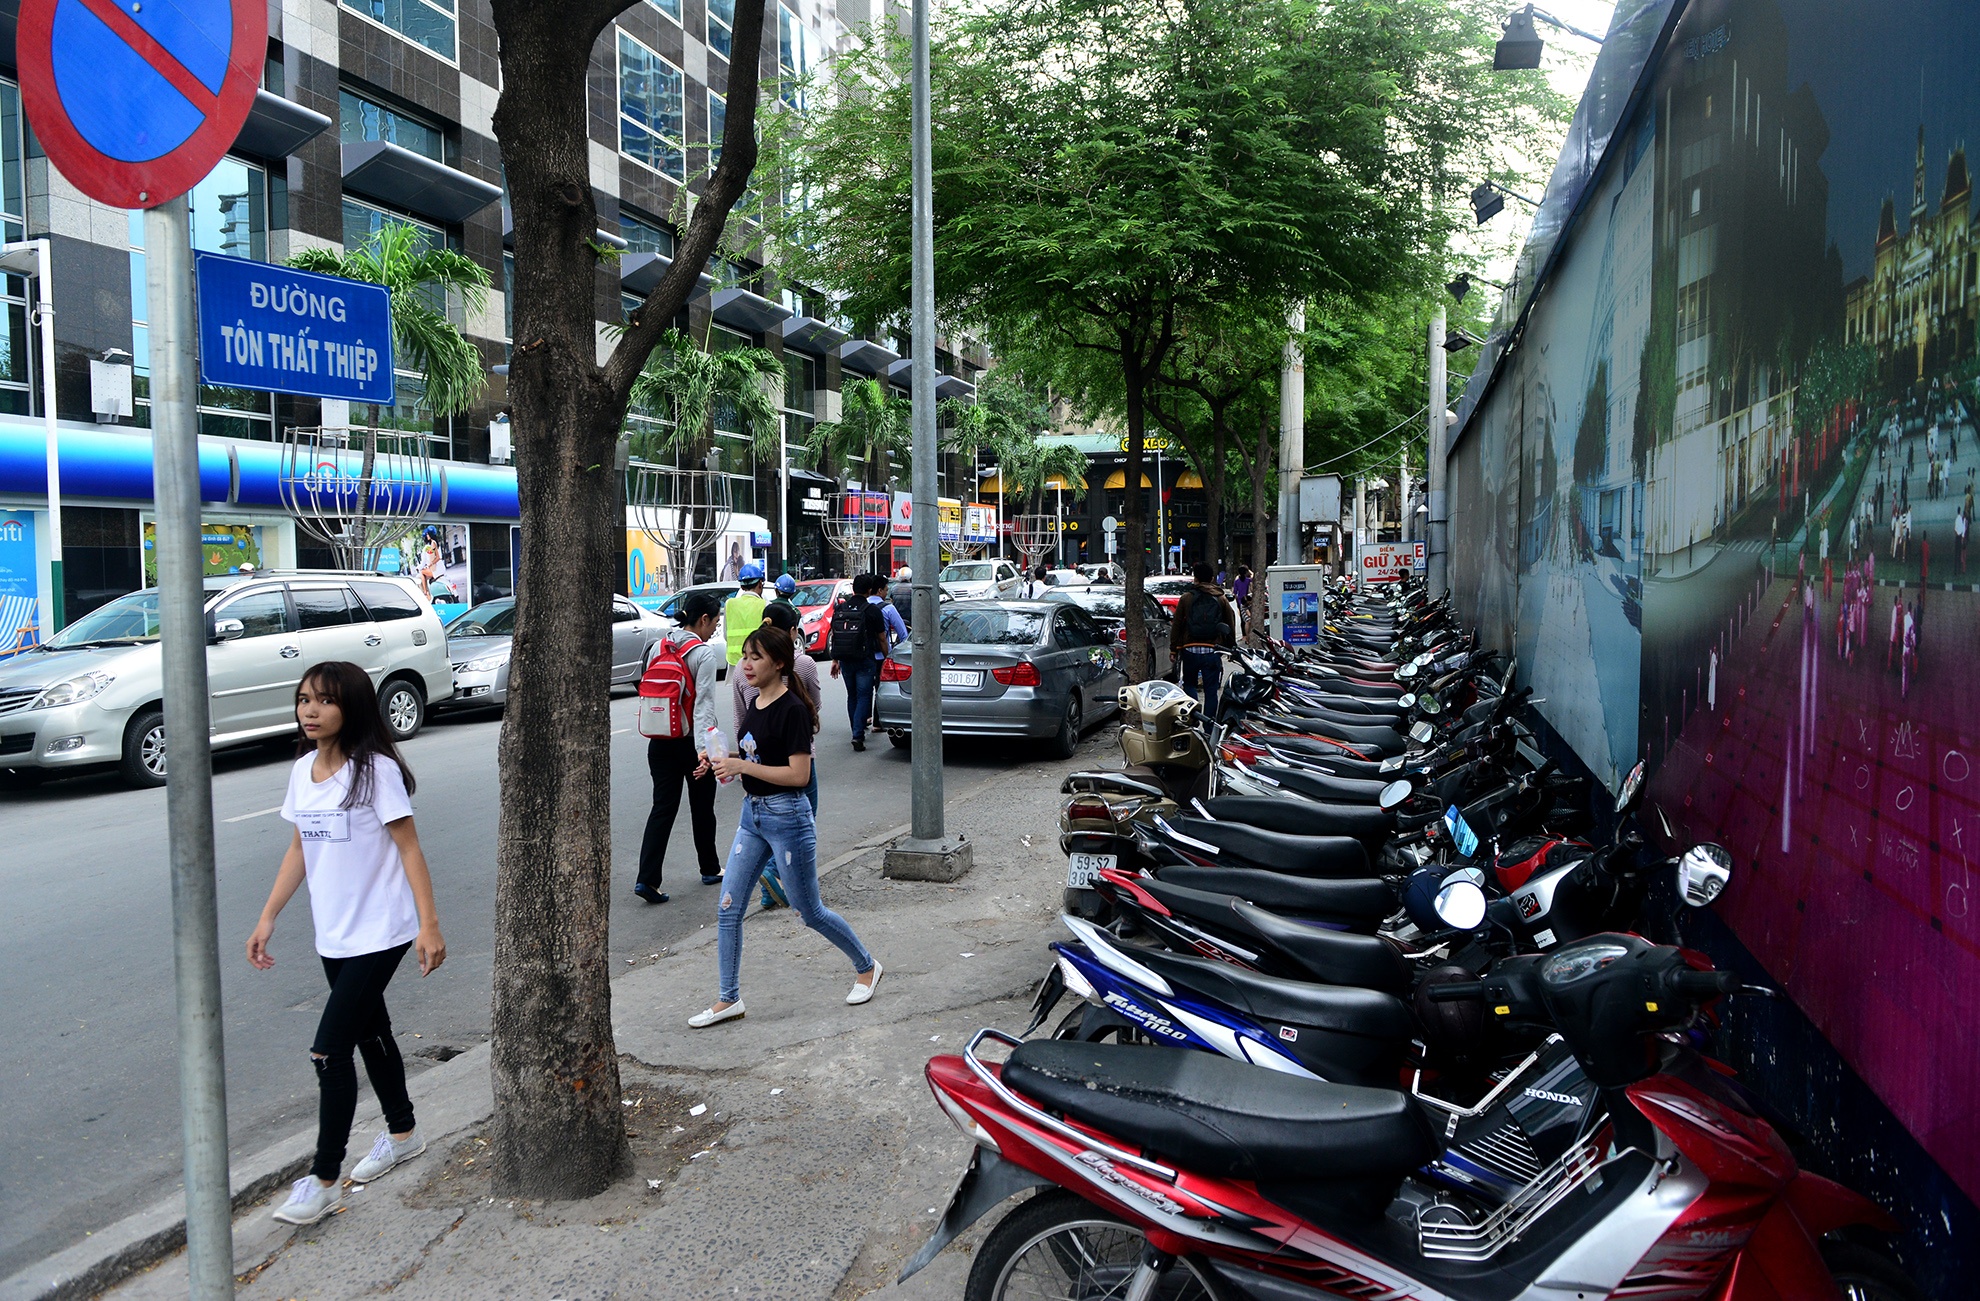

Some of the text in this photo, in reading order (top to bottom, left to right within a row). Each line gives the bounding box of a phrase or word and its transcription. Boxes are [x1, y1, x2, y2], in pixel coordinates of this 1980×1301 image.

[250, 282, 346, 323] ĐƯỜNG
[220, 318, 378, 390] TÔN THẤT THIỆP
[1363, 552, 1413, 568] GIỮ XE
[1077, 856, 1110, 871] 59-S2
[1143, 1020, 1187, 1040] neo
[1524, 1087, 1583, 1106] HONDA
[1688, 1231, 1729, 1246] SYM
